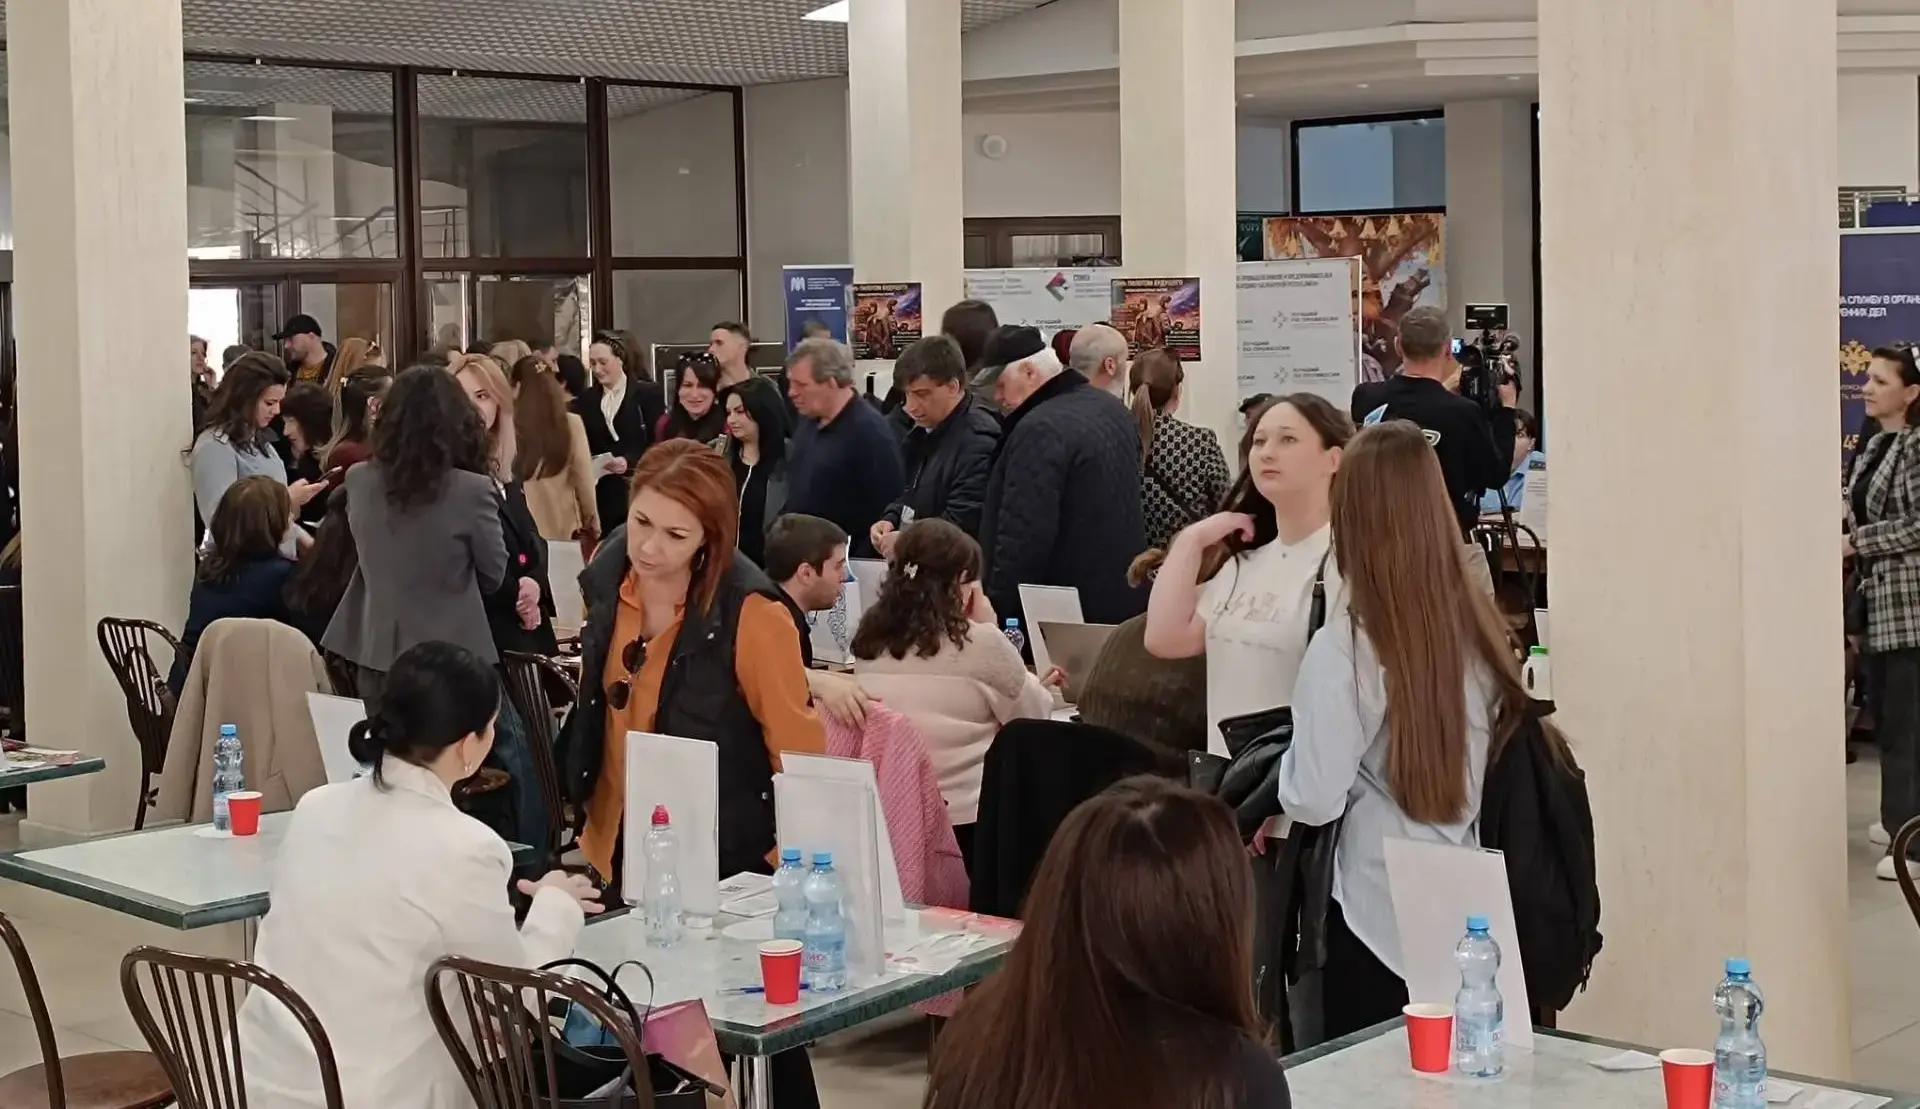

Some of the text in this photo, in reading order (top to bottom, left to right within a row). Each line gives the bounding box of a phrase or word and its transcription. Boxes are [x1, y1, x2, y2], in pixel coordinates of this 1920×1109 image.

[1847, 295, 1882, 304] СЛУЖБУ
[1883, 295, 1890, 304] В
[1868, 307, 1887, 318] ДЕЛ
